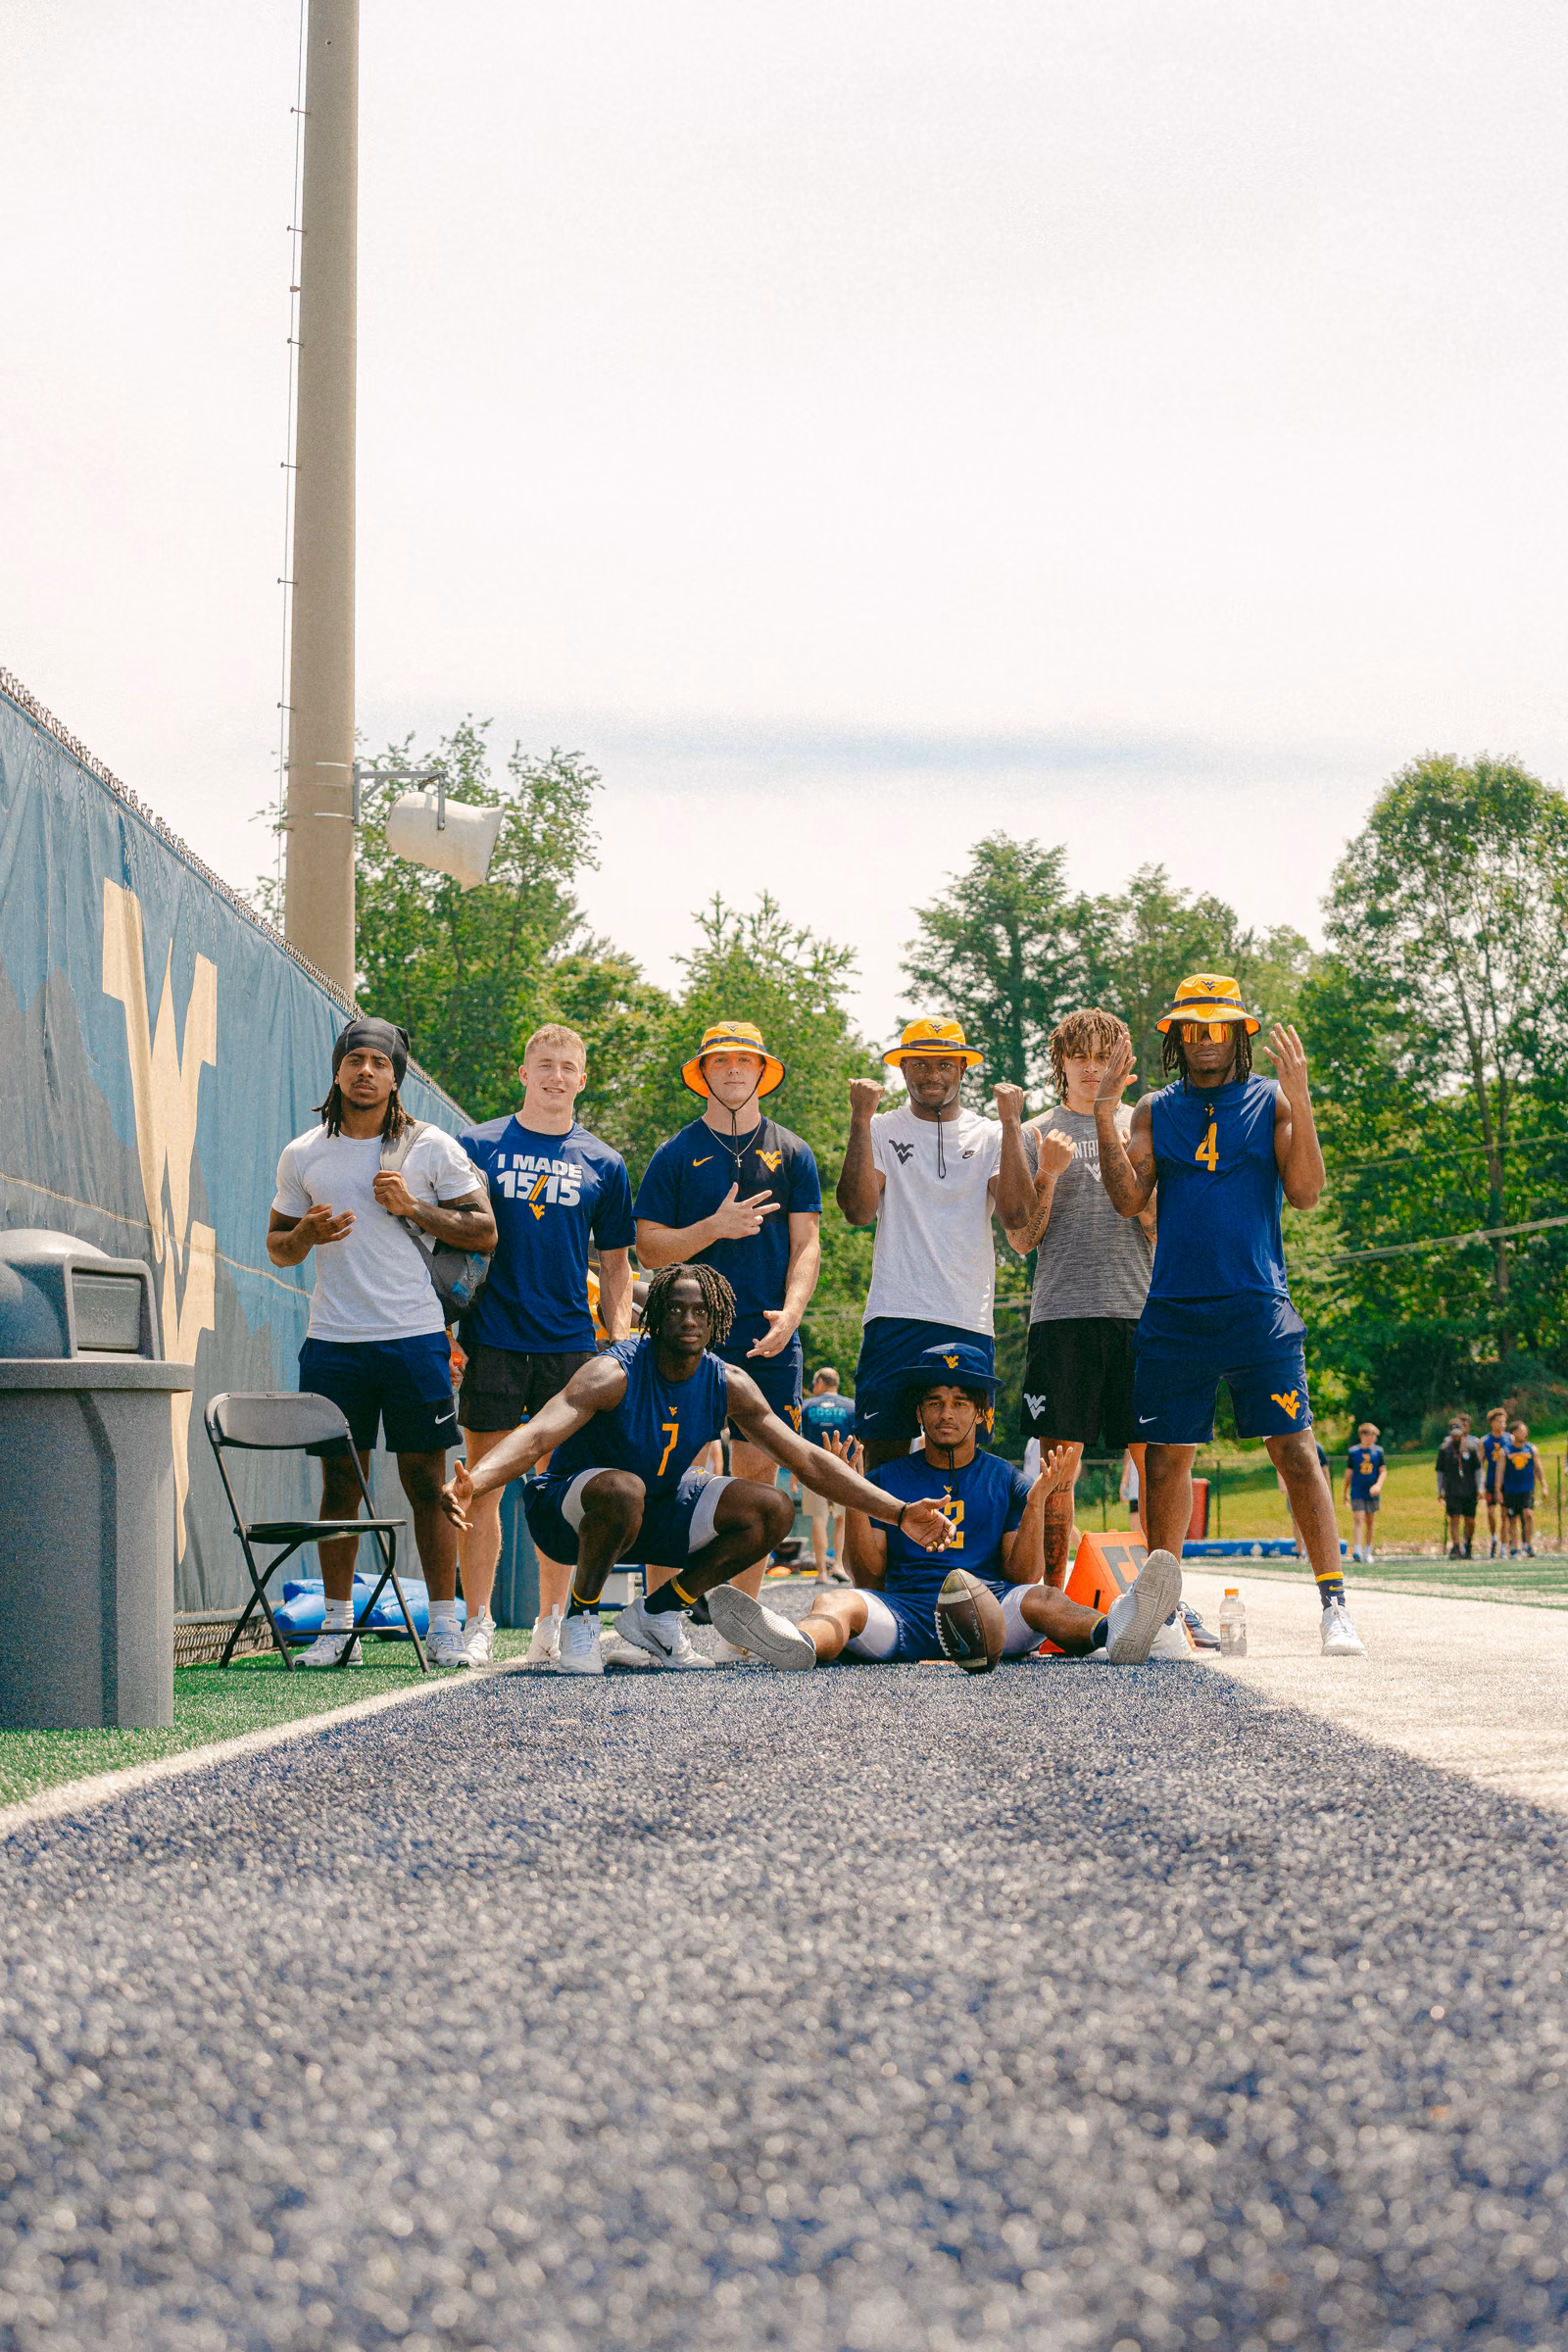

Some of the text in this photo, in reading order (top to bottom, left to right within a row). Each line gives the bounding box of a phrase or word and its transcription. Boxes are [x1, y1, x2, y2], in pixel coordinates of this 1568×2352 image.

[497, 1153, 582, 1180] I MADE
[1195, 1122, 1220, 1172] 4
[657, 1423, 679, 1477] 7
